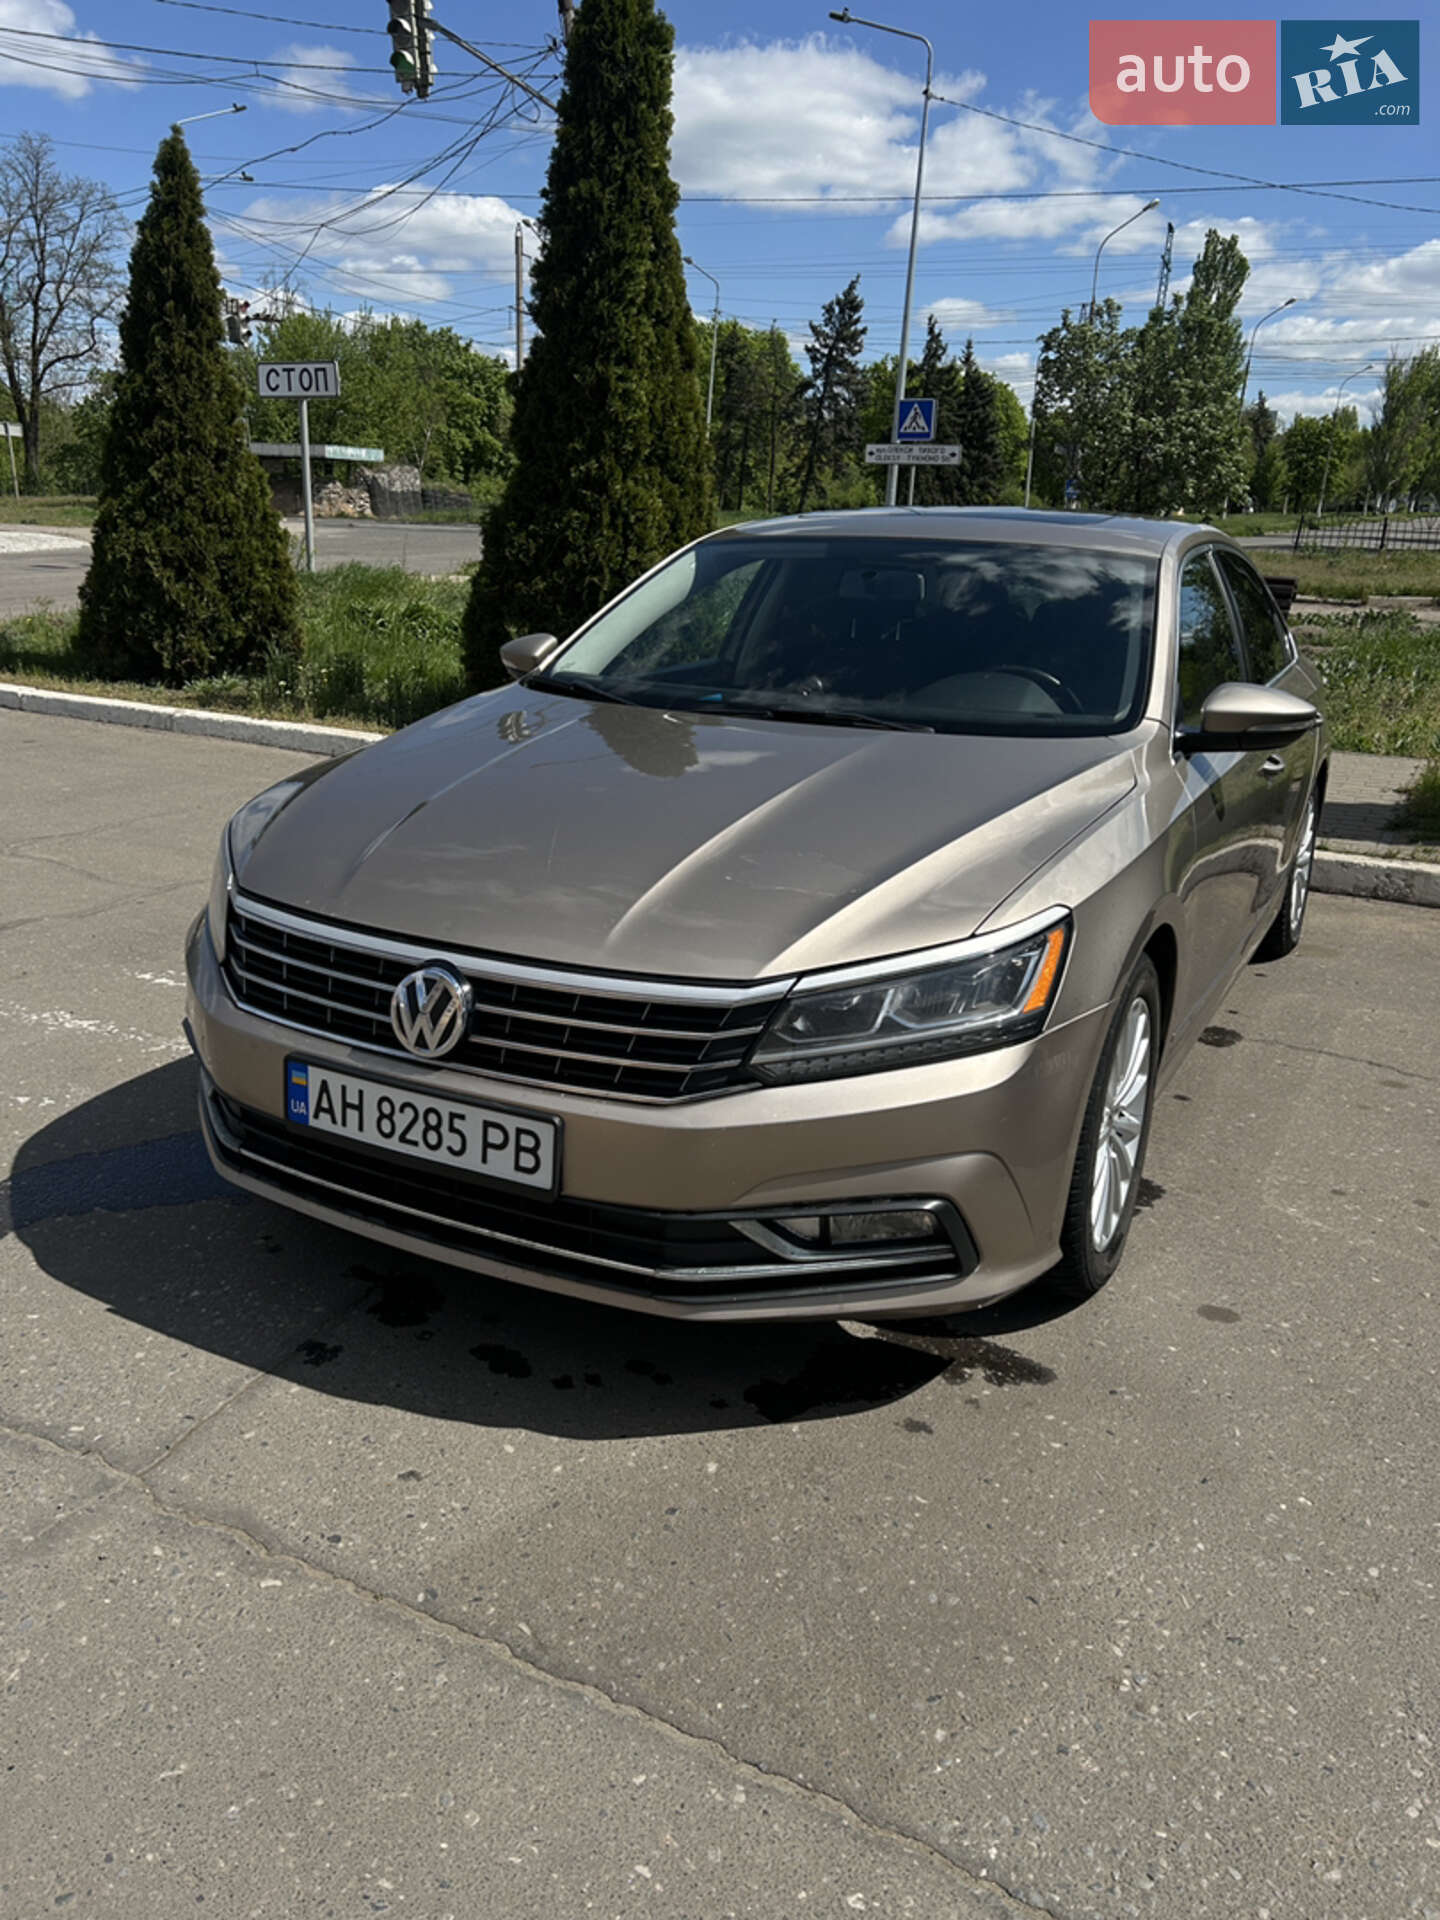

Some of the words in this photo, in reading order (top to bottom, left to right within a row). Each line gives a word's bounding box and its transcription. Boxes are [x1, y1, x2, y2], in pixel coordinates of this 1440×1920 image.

[266, 368, 329, 392] СТОП
[290, 1098, 307, 1116] UA
[313, 1079, 364, 1132] AH
[376, 1095, 467, 1157] 8285
[480, 1119, 542, 1175] PB
